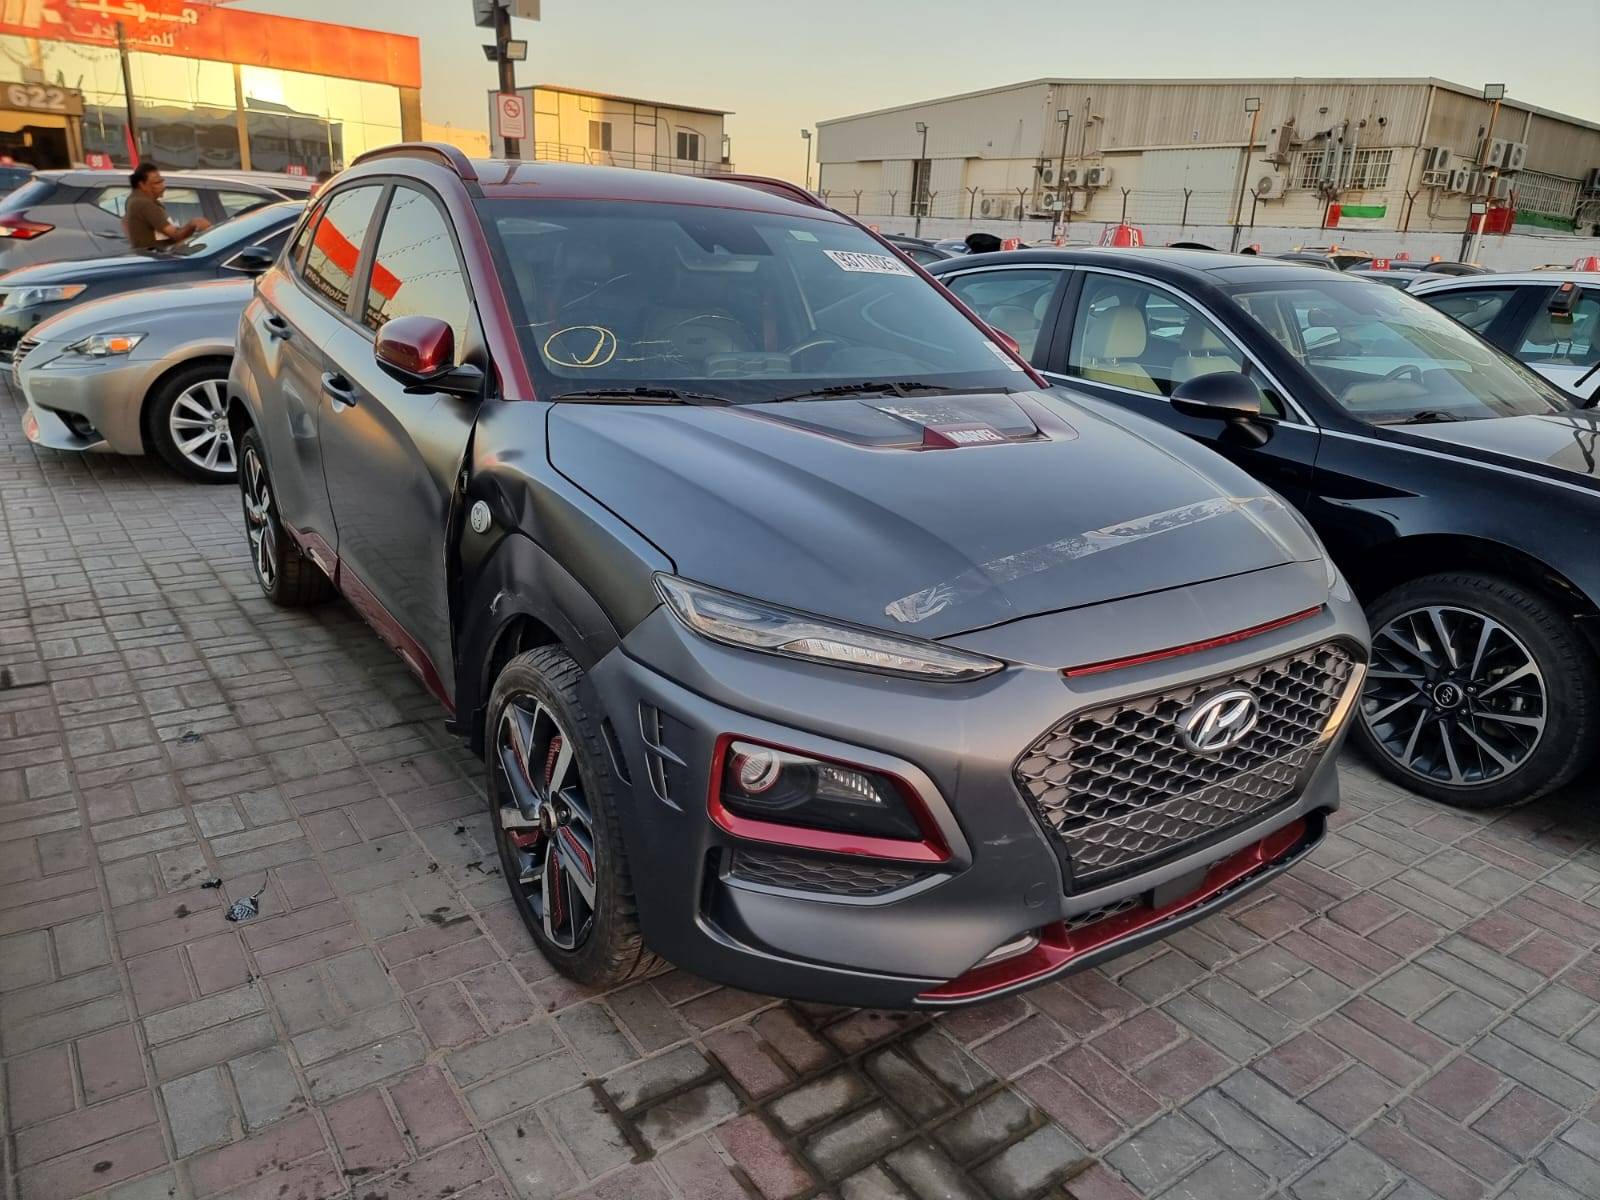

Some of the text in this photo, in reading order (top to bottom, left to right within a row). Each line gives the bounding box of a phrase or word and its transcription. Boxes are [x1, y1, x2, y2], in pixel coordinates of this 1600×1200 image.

[8, 84, 67, 109] 622
[1127, 228, 1140, 247] 79
[944, 428, 1004, 443] MARVEL
